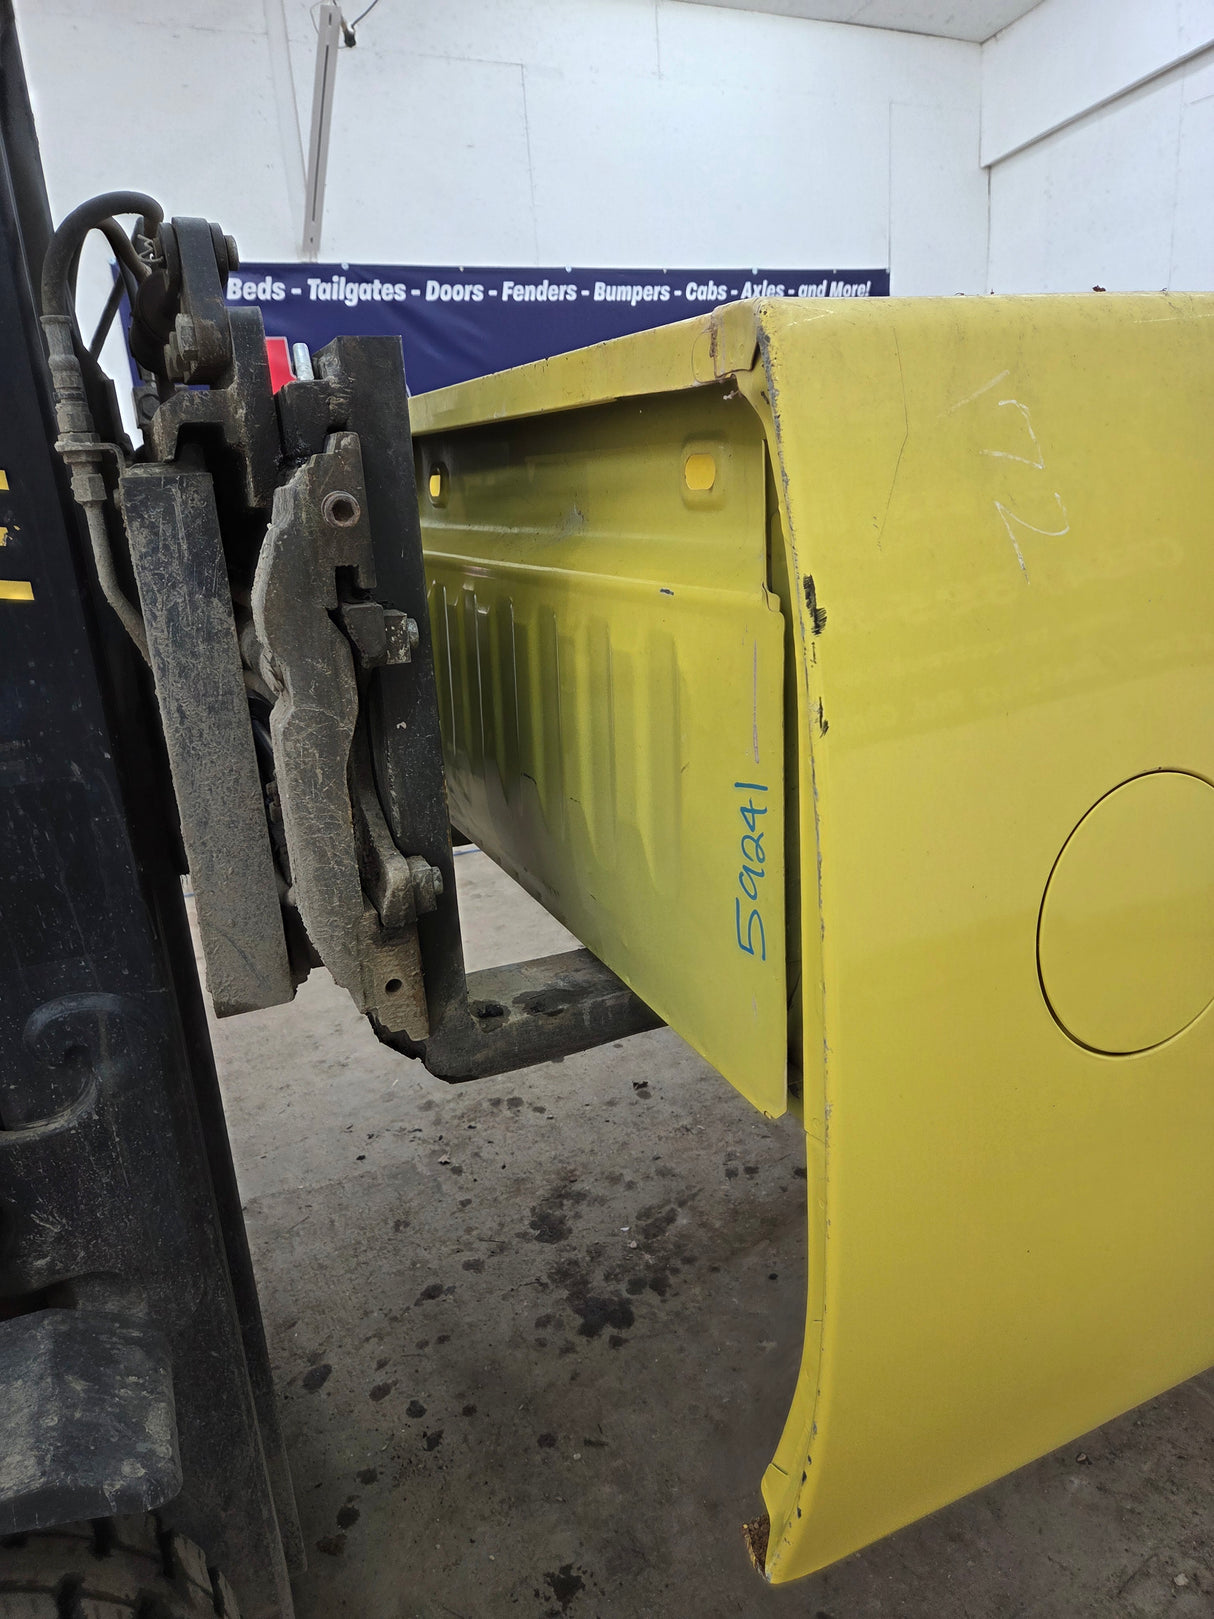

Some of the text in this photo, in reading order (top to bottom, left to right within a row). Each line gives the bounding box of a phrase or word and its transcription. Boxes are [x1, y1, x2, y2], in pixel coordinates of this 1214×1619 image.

[226, 276, 286, 301] Beds
[307, 275, 406, 307] Tailgates
[425, 280, 484, 302] Doors
[502, 280, 577, 302] Fenders
[593, 281, 671, 306] Bumpers
[685, 280, 727, 301] Cabs
[740, 279, 785, 299] Axles
[798, 279, 828, 297] and
[829, 280, 872, 297] More!
[734, 782, 768, 961] 59241
